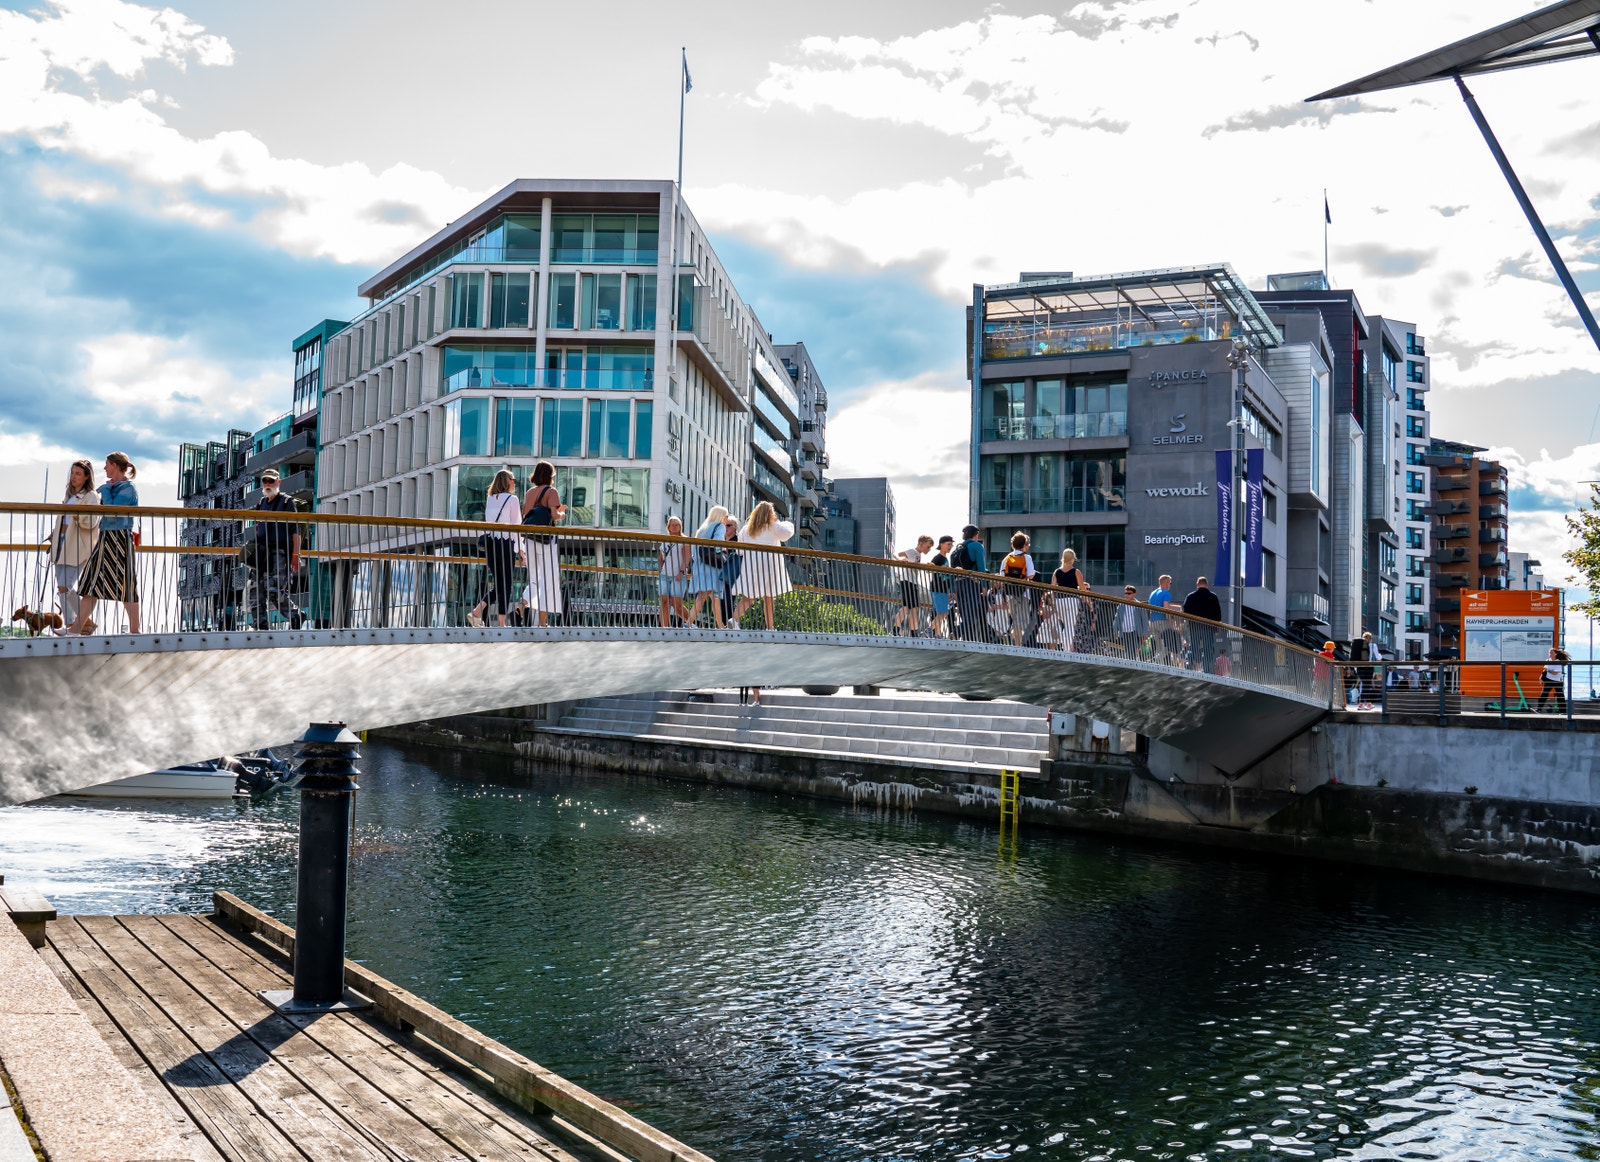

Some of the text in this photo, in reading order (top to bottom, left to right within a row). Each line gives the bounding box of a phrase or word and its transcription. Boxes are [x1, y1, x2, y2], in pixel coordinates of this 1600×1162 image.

[1156, 369, 1207, 380] PANGEA
[1152, 434, 1203, 445] SELMER
[1145, 481, 1210, 498] wework
